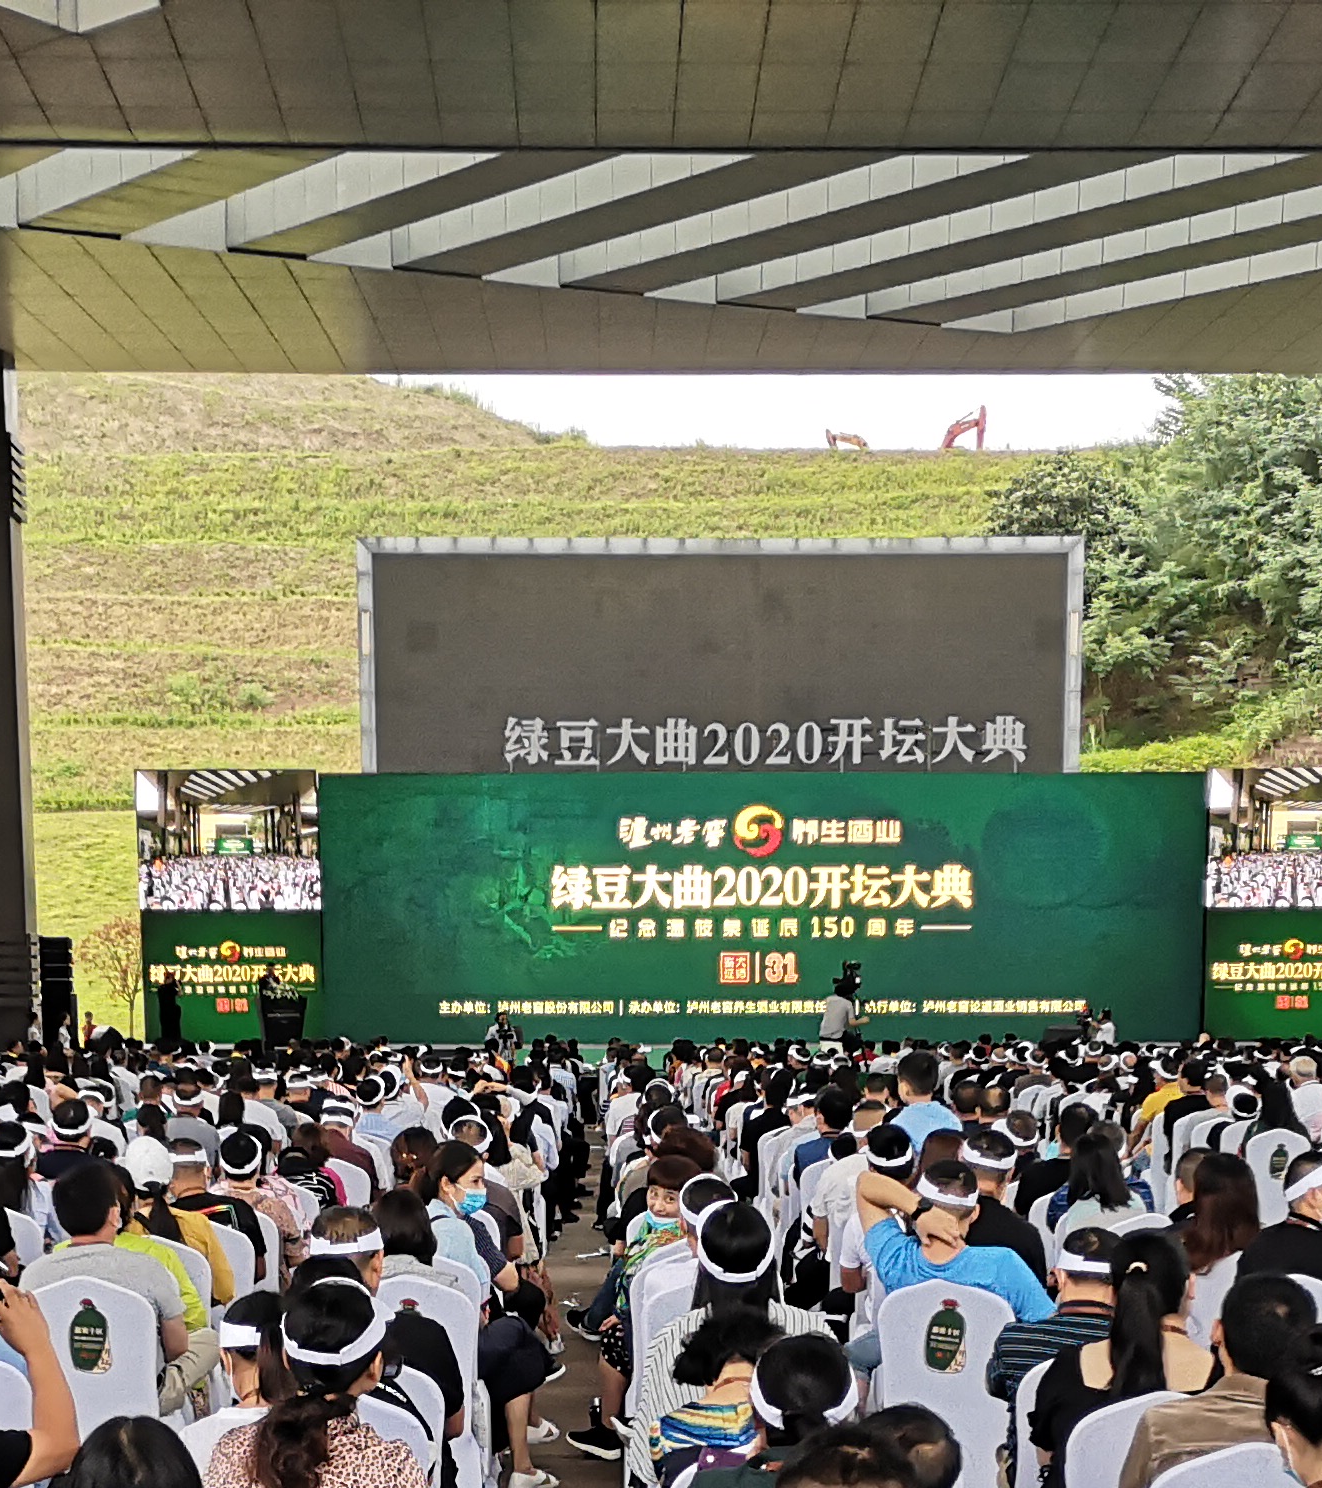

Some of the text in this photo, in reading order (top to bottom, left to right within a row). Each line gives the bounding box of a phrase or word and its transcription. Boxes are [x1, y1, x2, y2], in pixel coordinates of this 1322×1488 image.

[503, 715, 1027, 766] 绿豆大曲2020开坛大典
[551, 864, 973, 909] 绿豆大曲2020开坛大典
